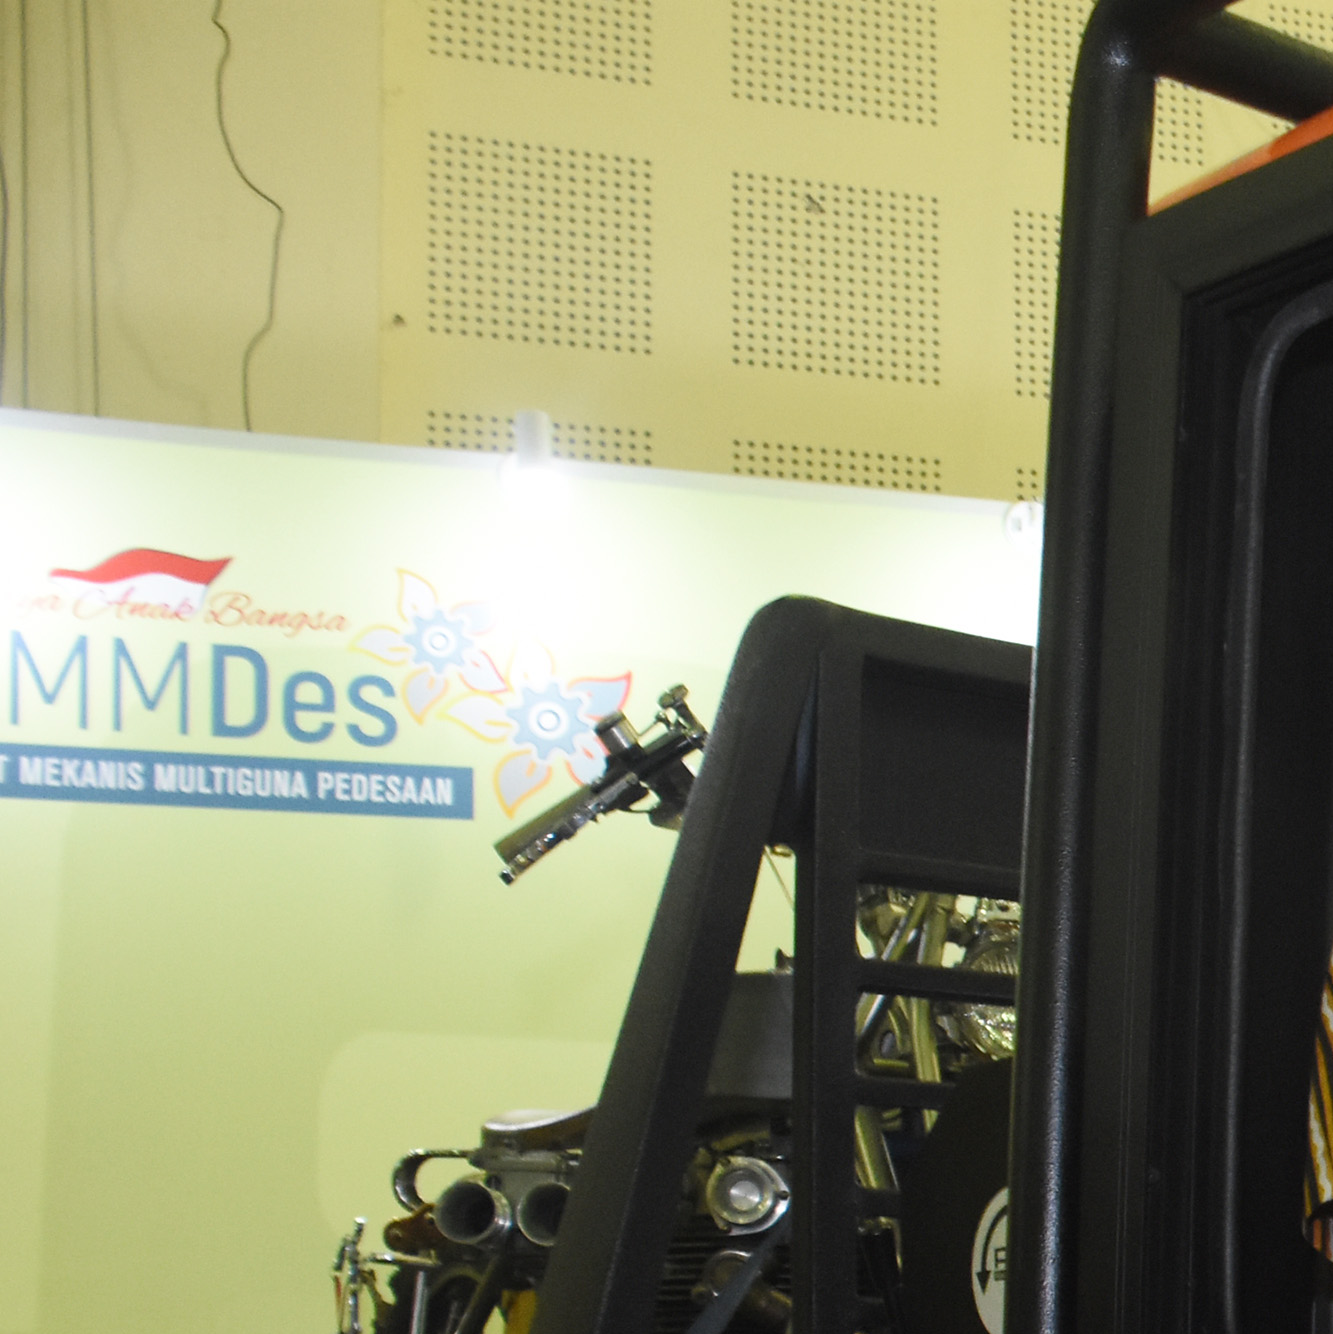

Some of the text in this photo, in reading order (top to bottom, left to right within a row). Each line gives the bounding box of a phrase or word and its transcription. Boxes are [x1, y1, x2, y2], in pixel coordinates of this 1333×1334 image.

[205, 590, 347, 638] Bangsa
[11, 629, 399, 748] MMDes
[19, 756, 145, 791] MEKANIS
[153, 763, 308, 799] MULTIGUNA
[317, 771, 454, 805] PEDESAAN
